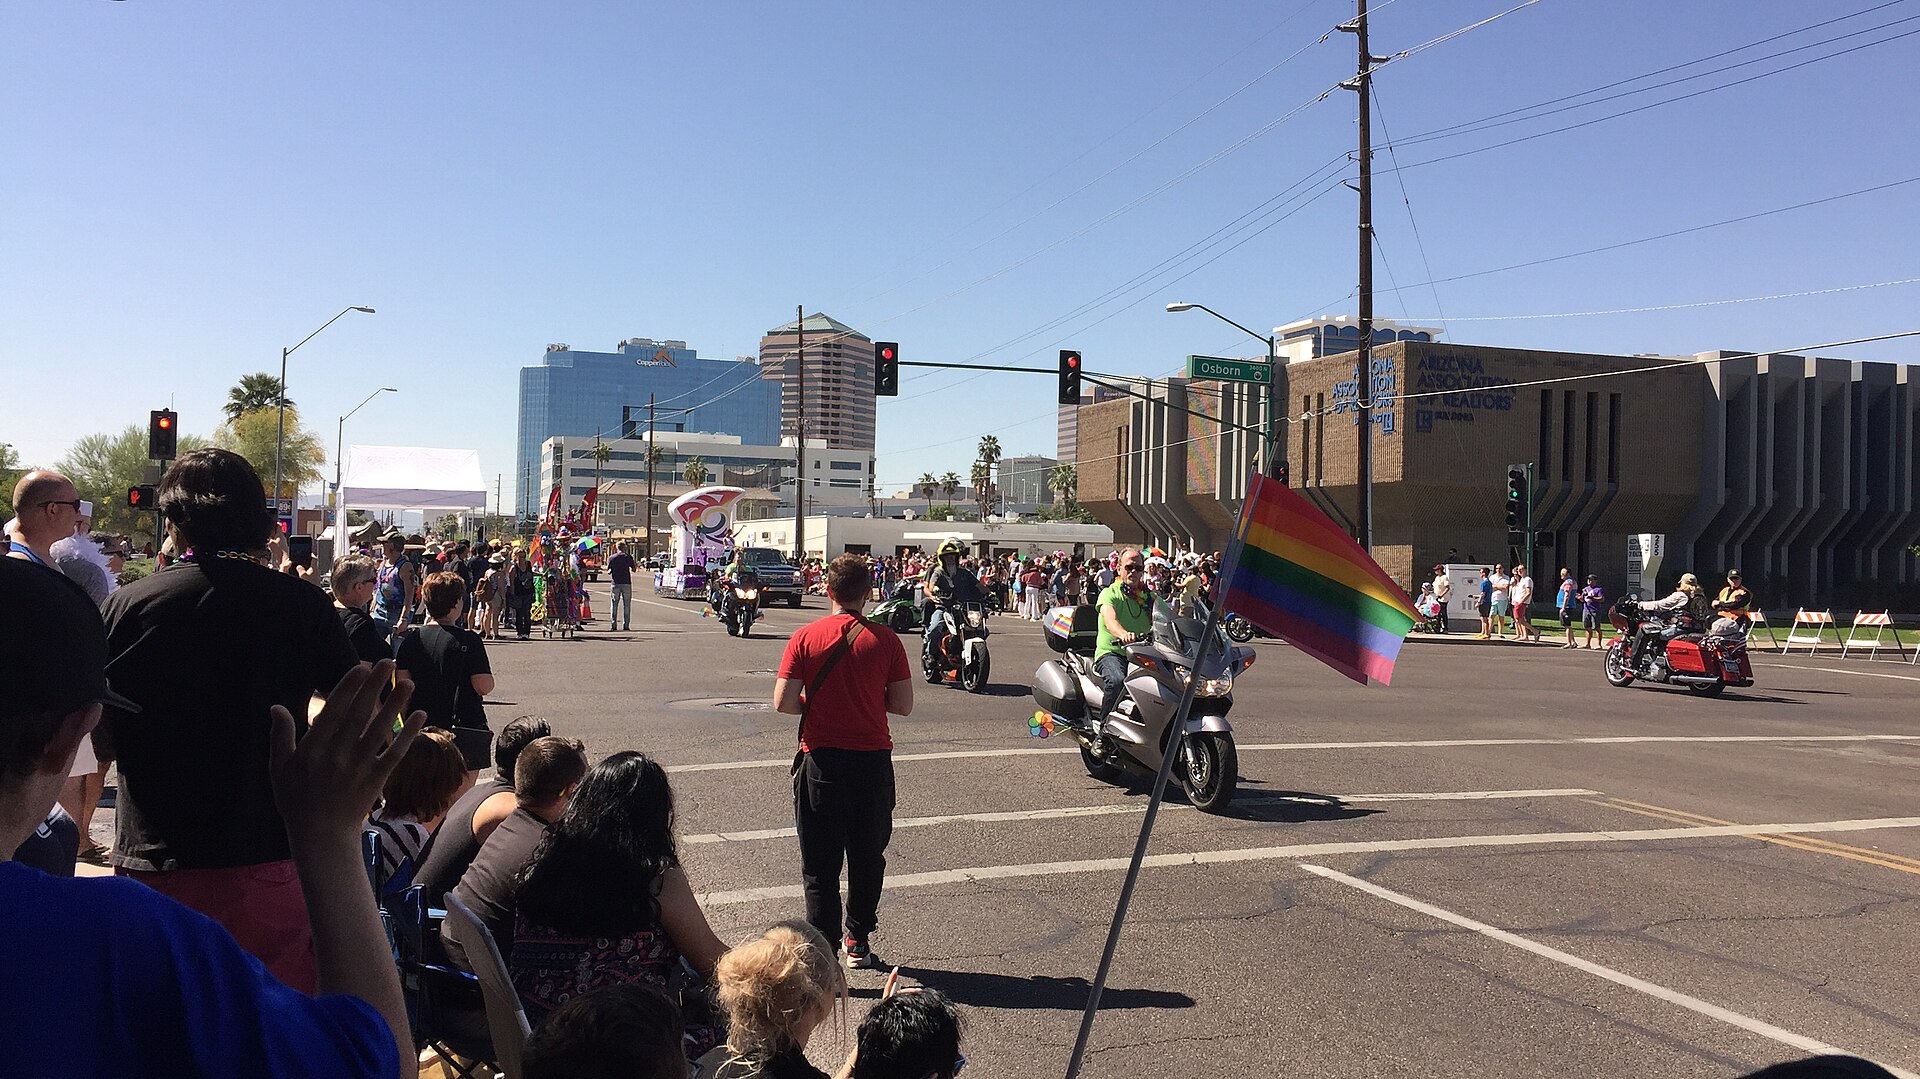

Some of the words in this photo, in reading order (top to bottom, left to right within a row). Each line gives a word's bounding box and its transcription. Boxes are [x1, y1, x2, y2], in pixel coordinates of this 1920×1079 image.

[1201, 362, 1240, 376] Osborn
[1353, 356, 1394, 378] AONA
[1418, 355, 1484, 374] ARIZONA
